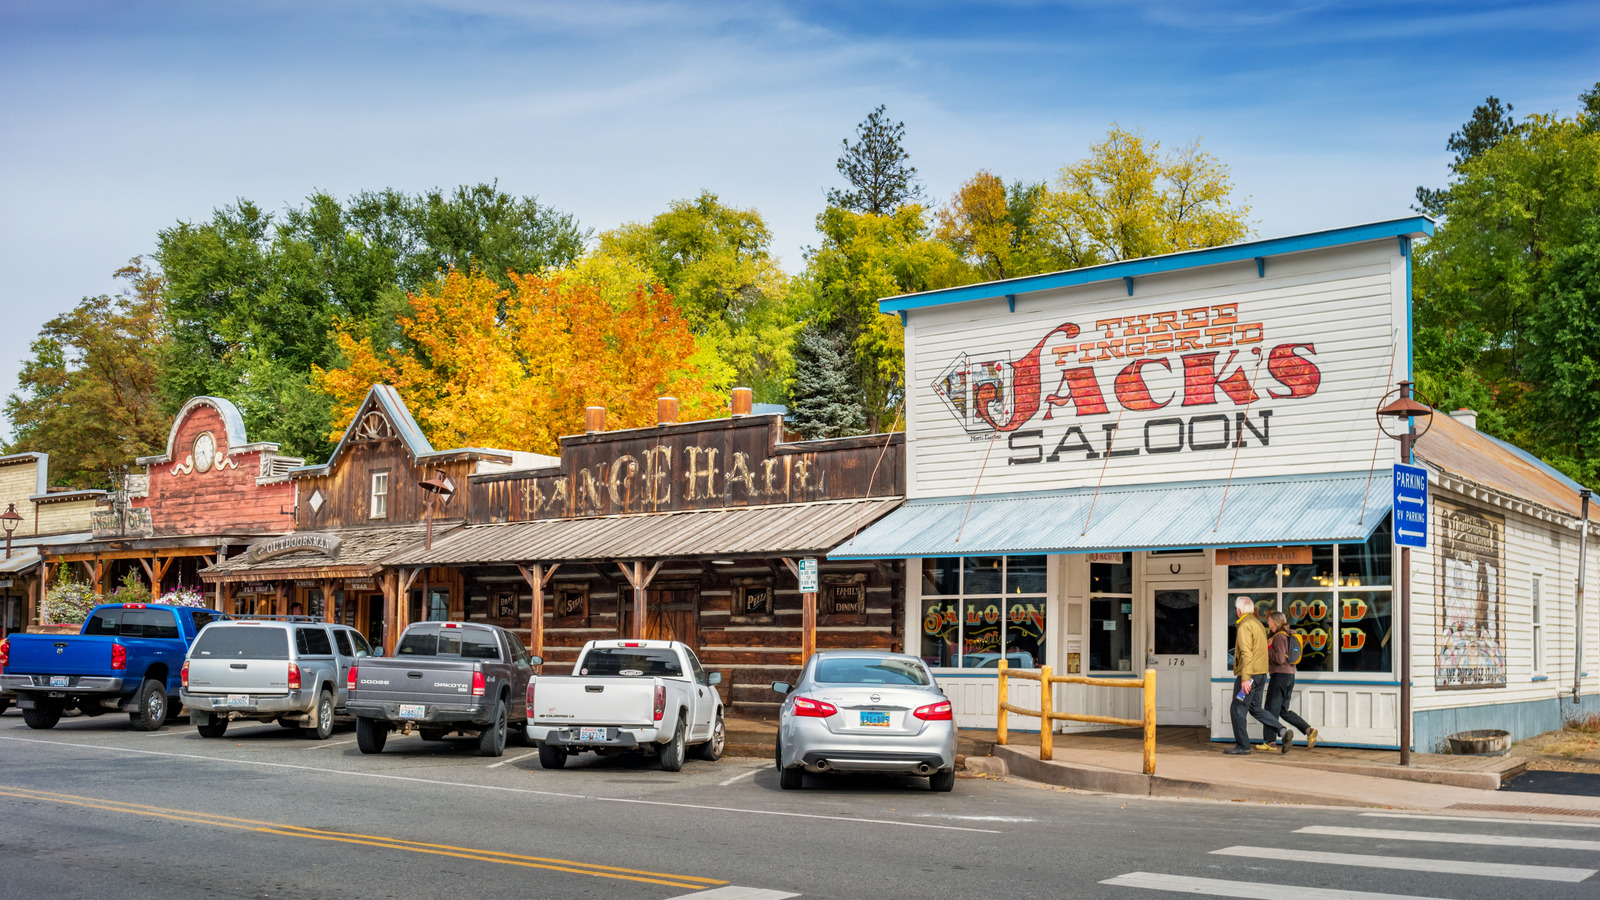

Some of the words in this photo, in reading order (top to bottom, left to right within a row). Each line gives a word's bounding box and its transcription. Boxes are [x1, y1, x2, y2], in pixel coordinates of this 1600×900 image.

[1096, 302, 1239, 338] THREE
[1051, 322, 1264, 366] FINGERED
[974, 322, 1321, 433] JACK'S
[1008, 409, 1273, 465] SALOON
[521, 444, 673, 514] DANCE
[1396, 471, 1425, 491] PARKING
[1396, 509, 1404, 520] RV
[1405, 510, 1425, 523] PARKING
[266, 535, 332, 554] OUTDOORSMAN
[1229, 551, 1296, 564] Restaurant
[924, 602, 1045, 635] SALOON
[1253, 598, 1367, 624] GOOD
[1168, 657, 1185, 667] 176
